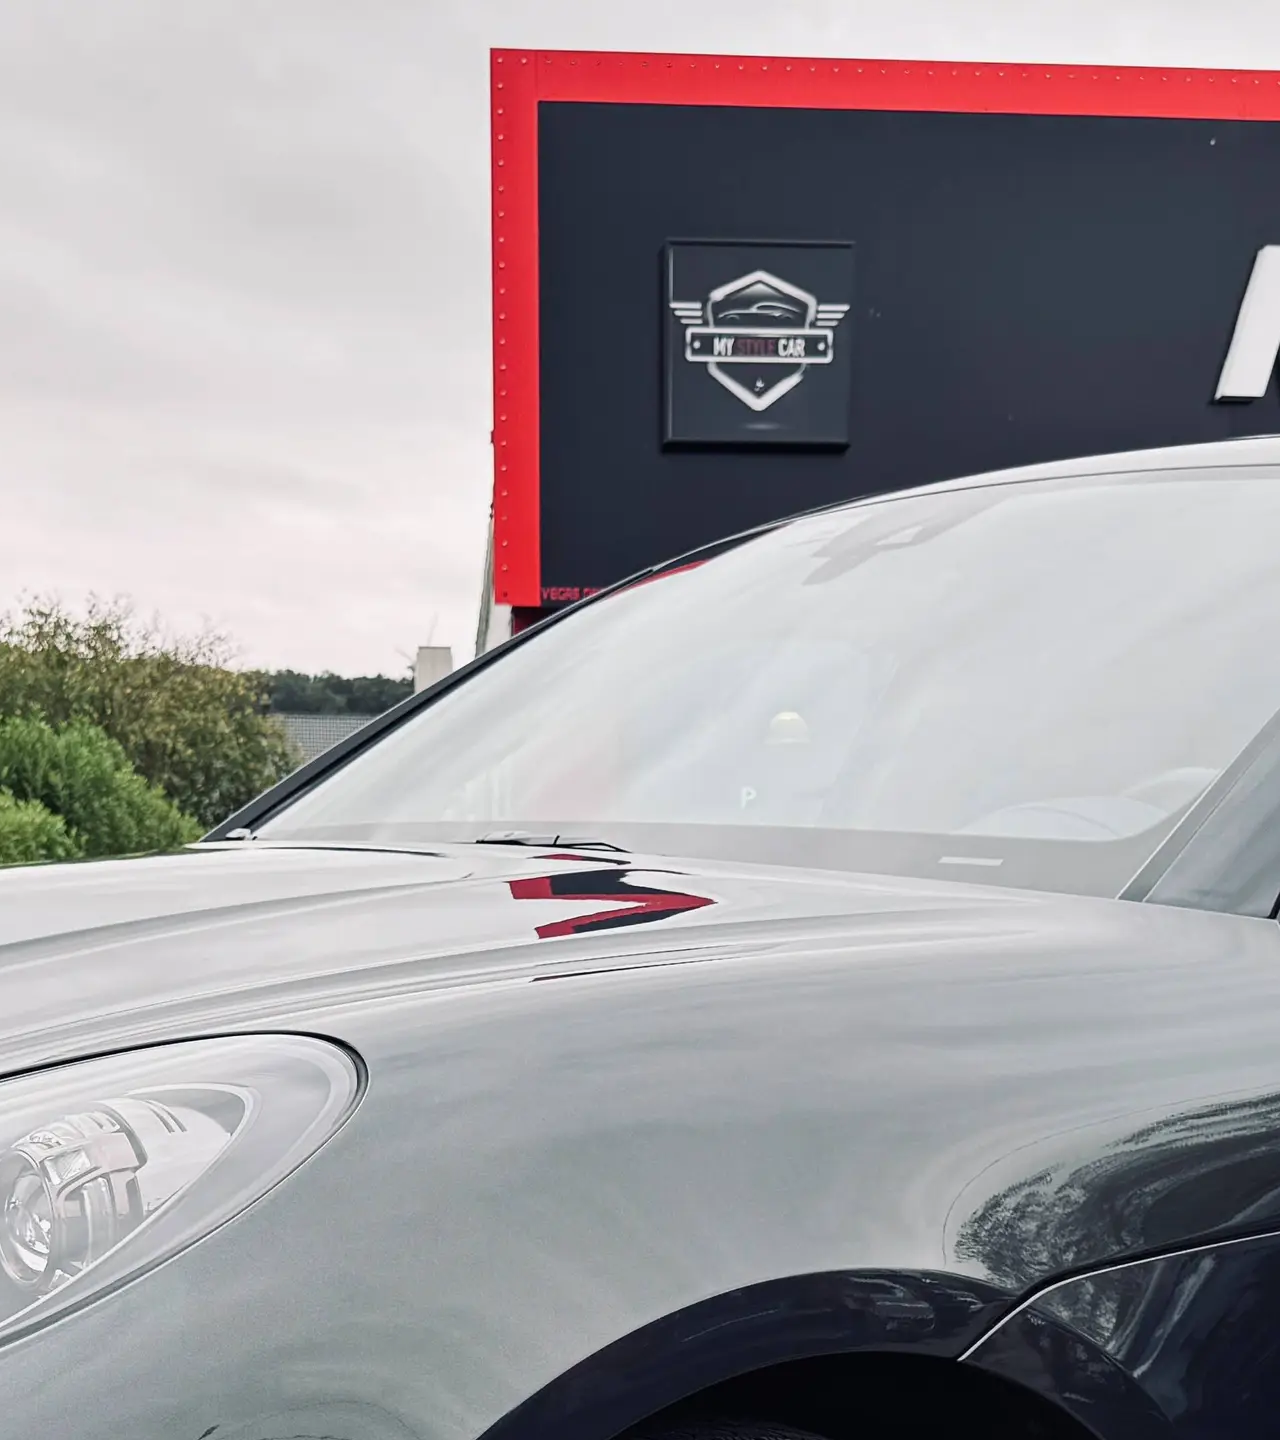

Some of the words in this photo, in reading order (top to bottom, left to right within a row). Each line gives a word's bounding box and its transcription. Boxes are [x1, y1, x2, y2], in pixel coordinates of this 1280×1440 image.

[713, 337, 734, 357] MY
[736, 337, 776, 357] STYLE
[777, 337, 806, 357] CAR
